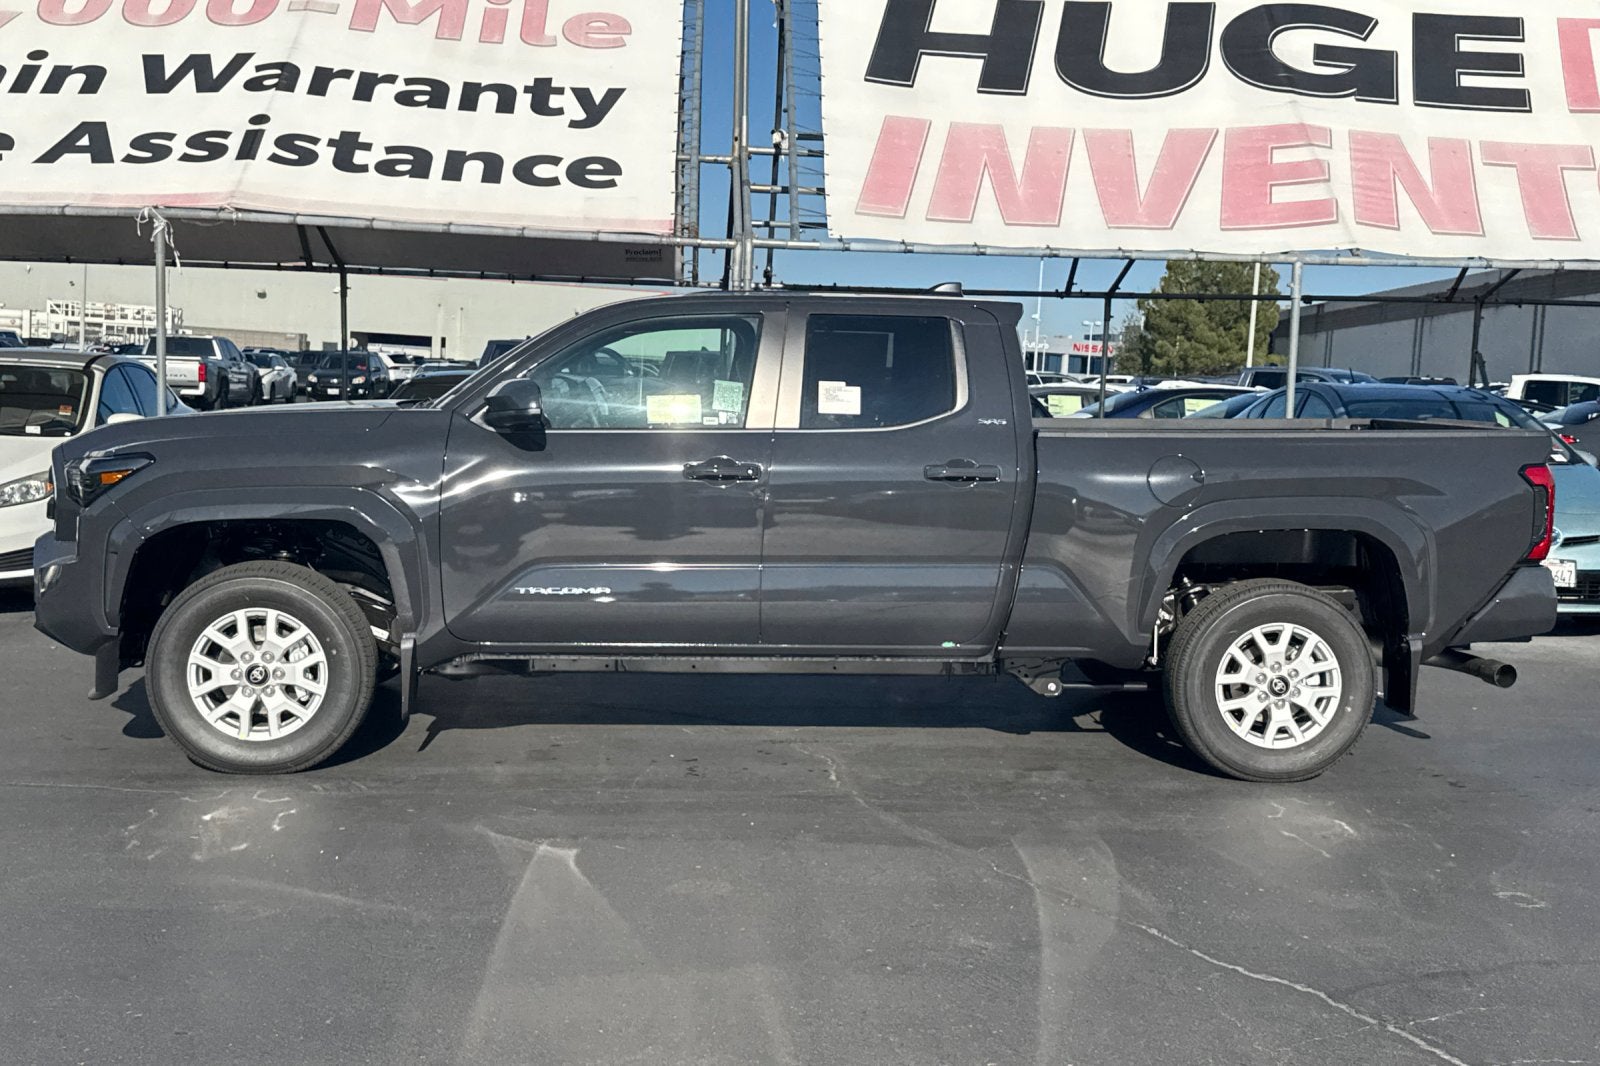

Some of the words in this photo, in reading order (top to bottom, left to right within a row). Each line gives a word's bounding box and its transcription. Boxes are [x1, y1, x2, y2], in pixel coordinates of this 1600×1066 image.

[0, 49, 107, 94] in
[142, 52, 627, 129] Warranty
[864, 0, 1532, 113] HUGE
[32, 114, 624, 189] Assistance
[855, 115, 1600, 241] INVENT
[514, 586, 611, 595] TACOMA
